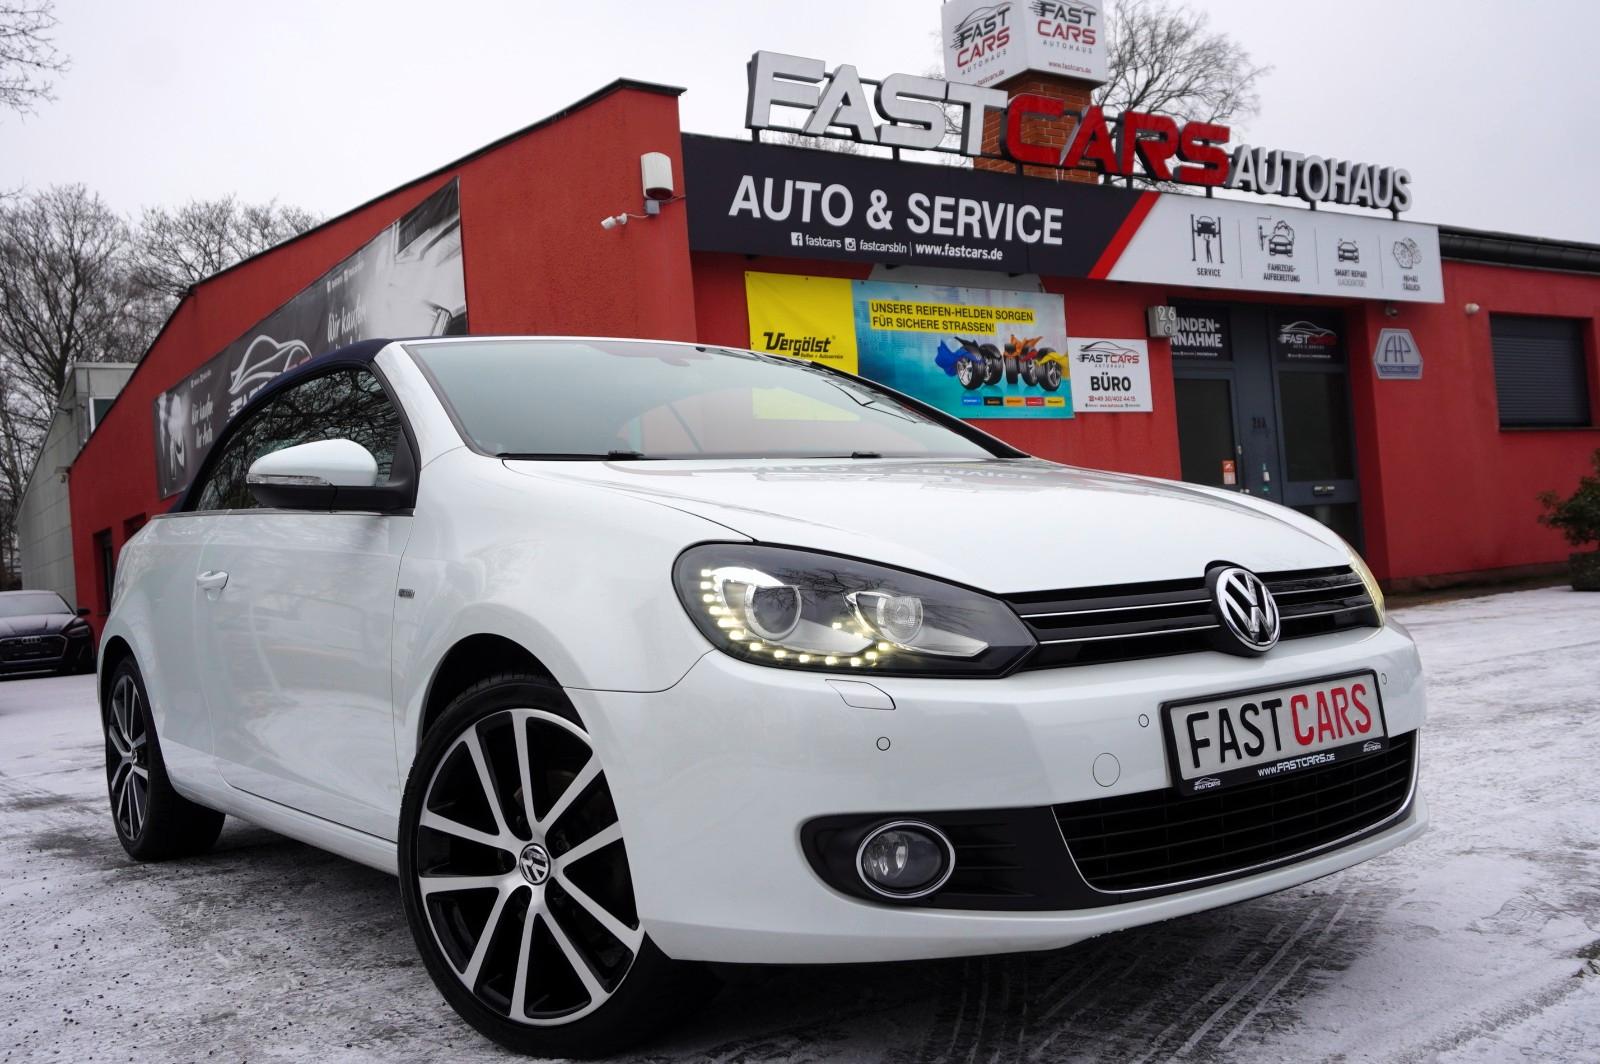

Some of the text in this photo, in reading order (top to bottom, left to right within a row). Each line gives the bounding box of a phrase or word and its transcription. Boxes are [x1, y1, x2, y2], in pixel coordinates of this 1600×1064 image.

[956, 7, 1011, 48] FAST
[1037, 2, 1097, 27] FAST
[1037, 19, 1096, 46] CARS
[957, 27, 1010, 68] CARS
[1042, 39, 1093, 54] AUTOHAUS
[961, 49, 1008, 75] AUTOHAUS
[1230, 144, 1413, 212] AUTOHAUS
[728, 175, 1064, 245] AUTO & SERVICE
[805, 234, 1003, 261] fastcars fastcarsbln www.fastcars.de
[1196, 267, 1222, 278] SERVICE
[871, 302, 1034, 321] UNSERE REIFEN-HELDEN SORGEN
[873, 314, 995, 333] FÜR SICHERE STRASSEN!
[1157, 305, 1176, 321] 26
[1176, 316, 1220, 332] UNDEN-
[763, 331, 832, 357] Vergölst
[1090, 371, 1131, 392] BÜRO
[1185, 683, 1372, 769] FAST CARS
